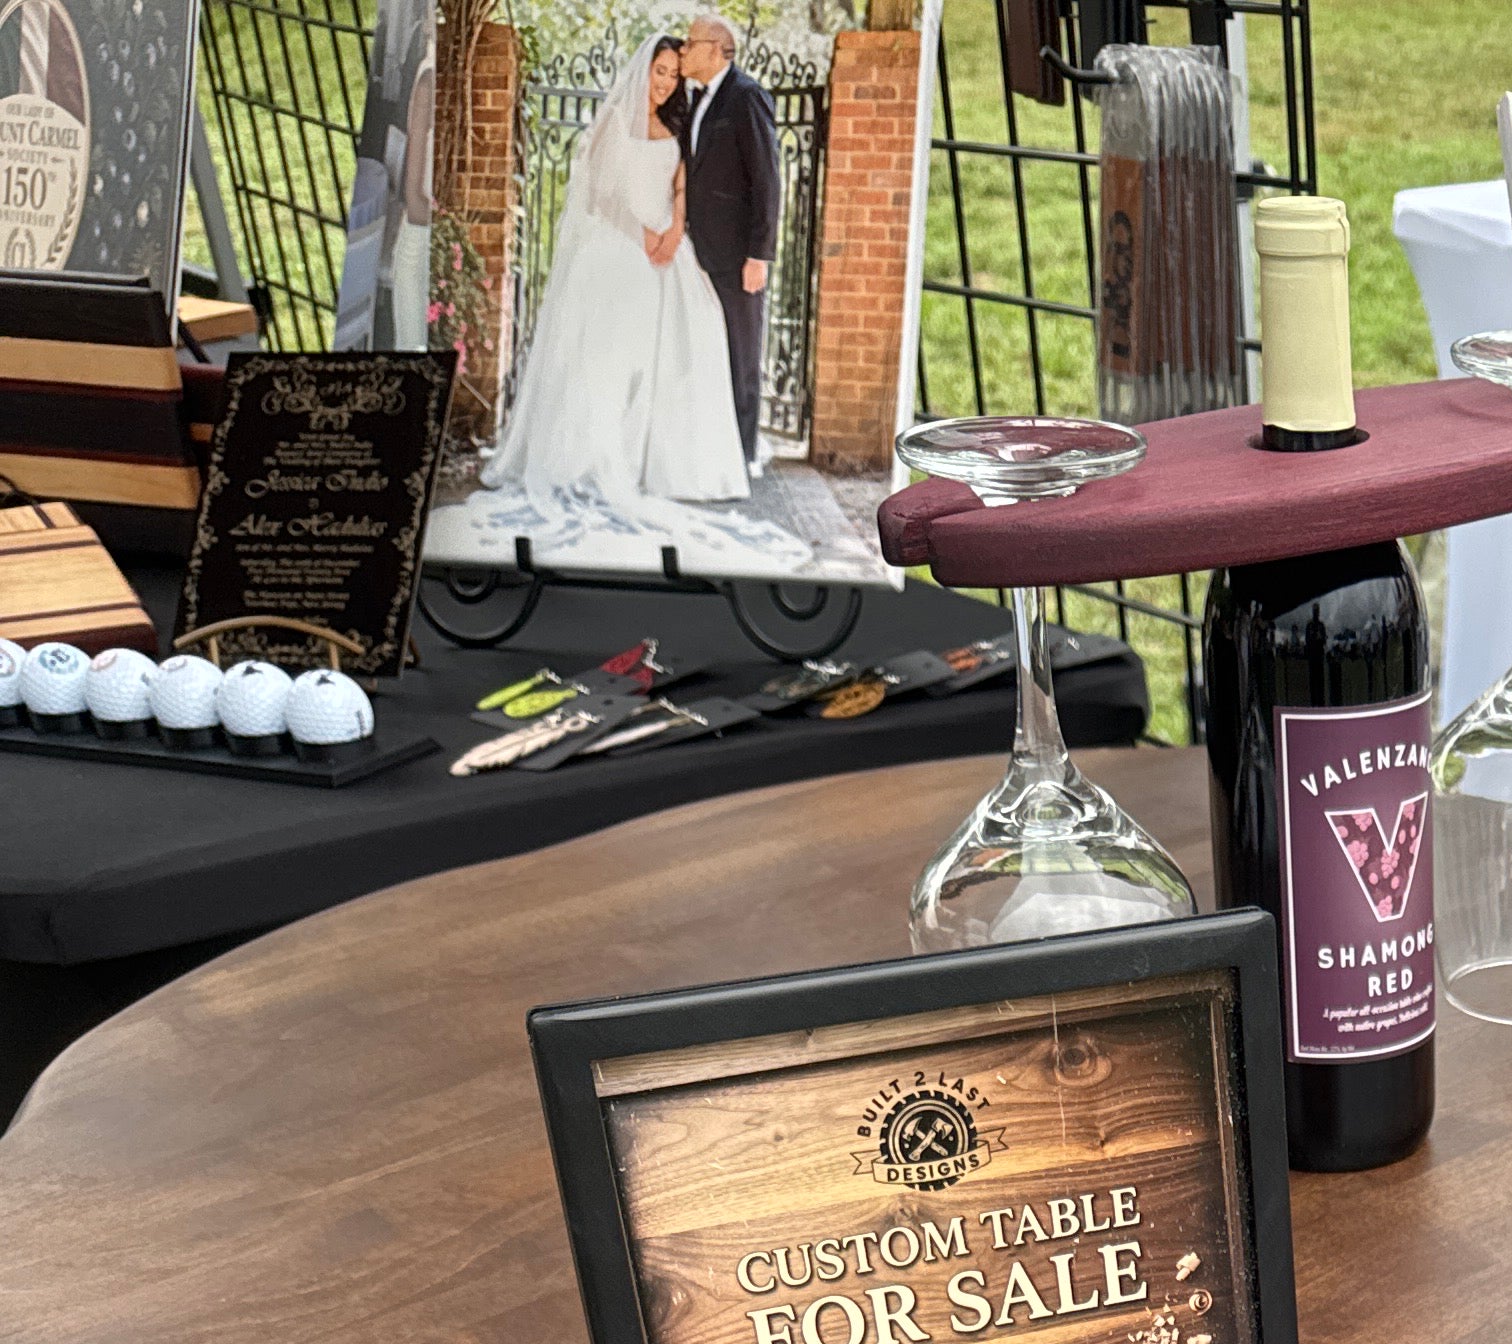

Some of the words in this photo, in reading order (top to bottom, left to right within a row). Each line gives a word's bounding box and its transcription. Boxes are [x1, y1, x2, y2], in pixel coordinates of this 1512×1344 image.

[1317, 922, 1434, 970] SHAMONG
[1367, 968, 1414, 998] RED
[857, 1079, 902, 1138] BUILT
[913, 1071, 926, 1087] 2
[938, 1072, 991, 1111] LAST
[887, 1154, 980, 1183] DESIGNS
[736, 1216, 970, 1294] CUSTOM
[979, 1186, 1142, 1249] TABLE
[946, 1241, 1148, 1333] SALE
